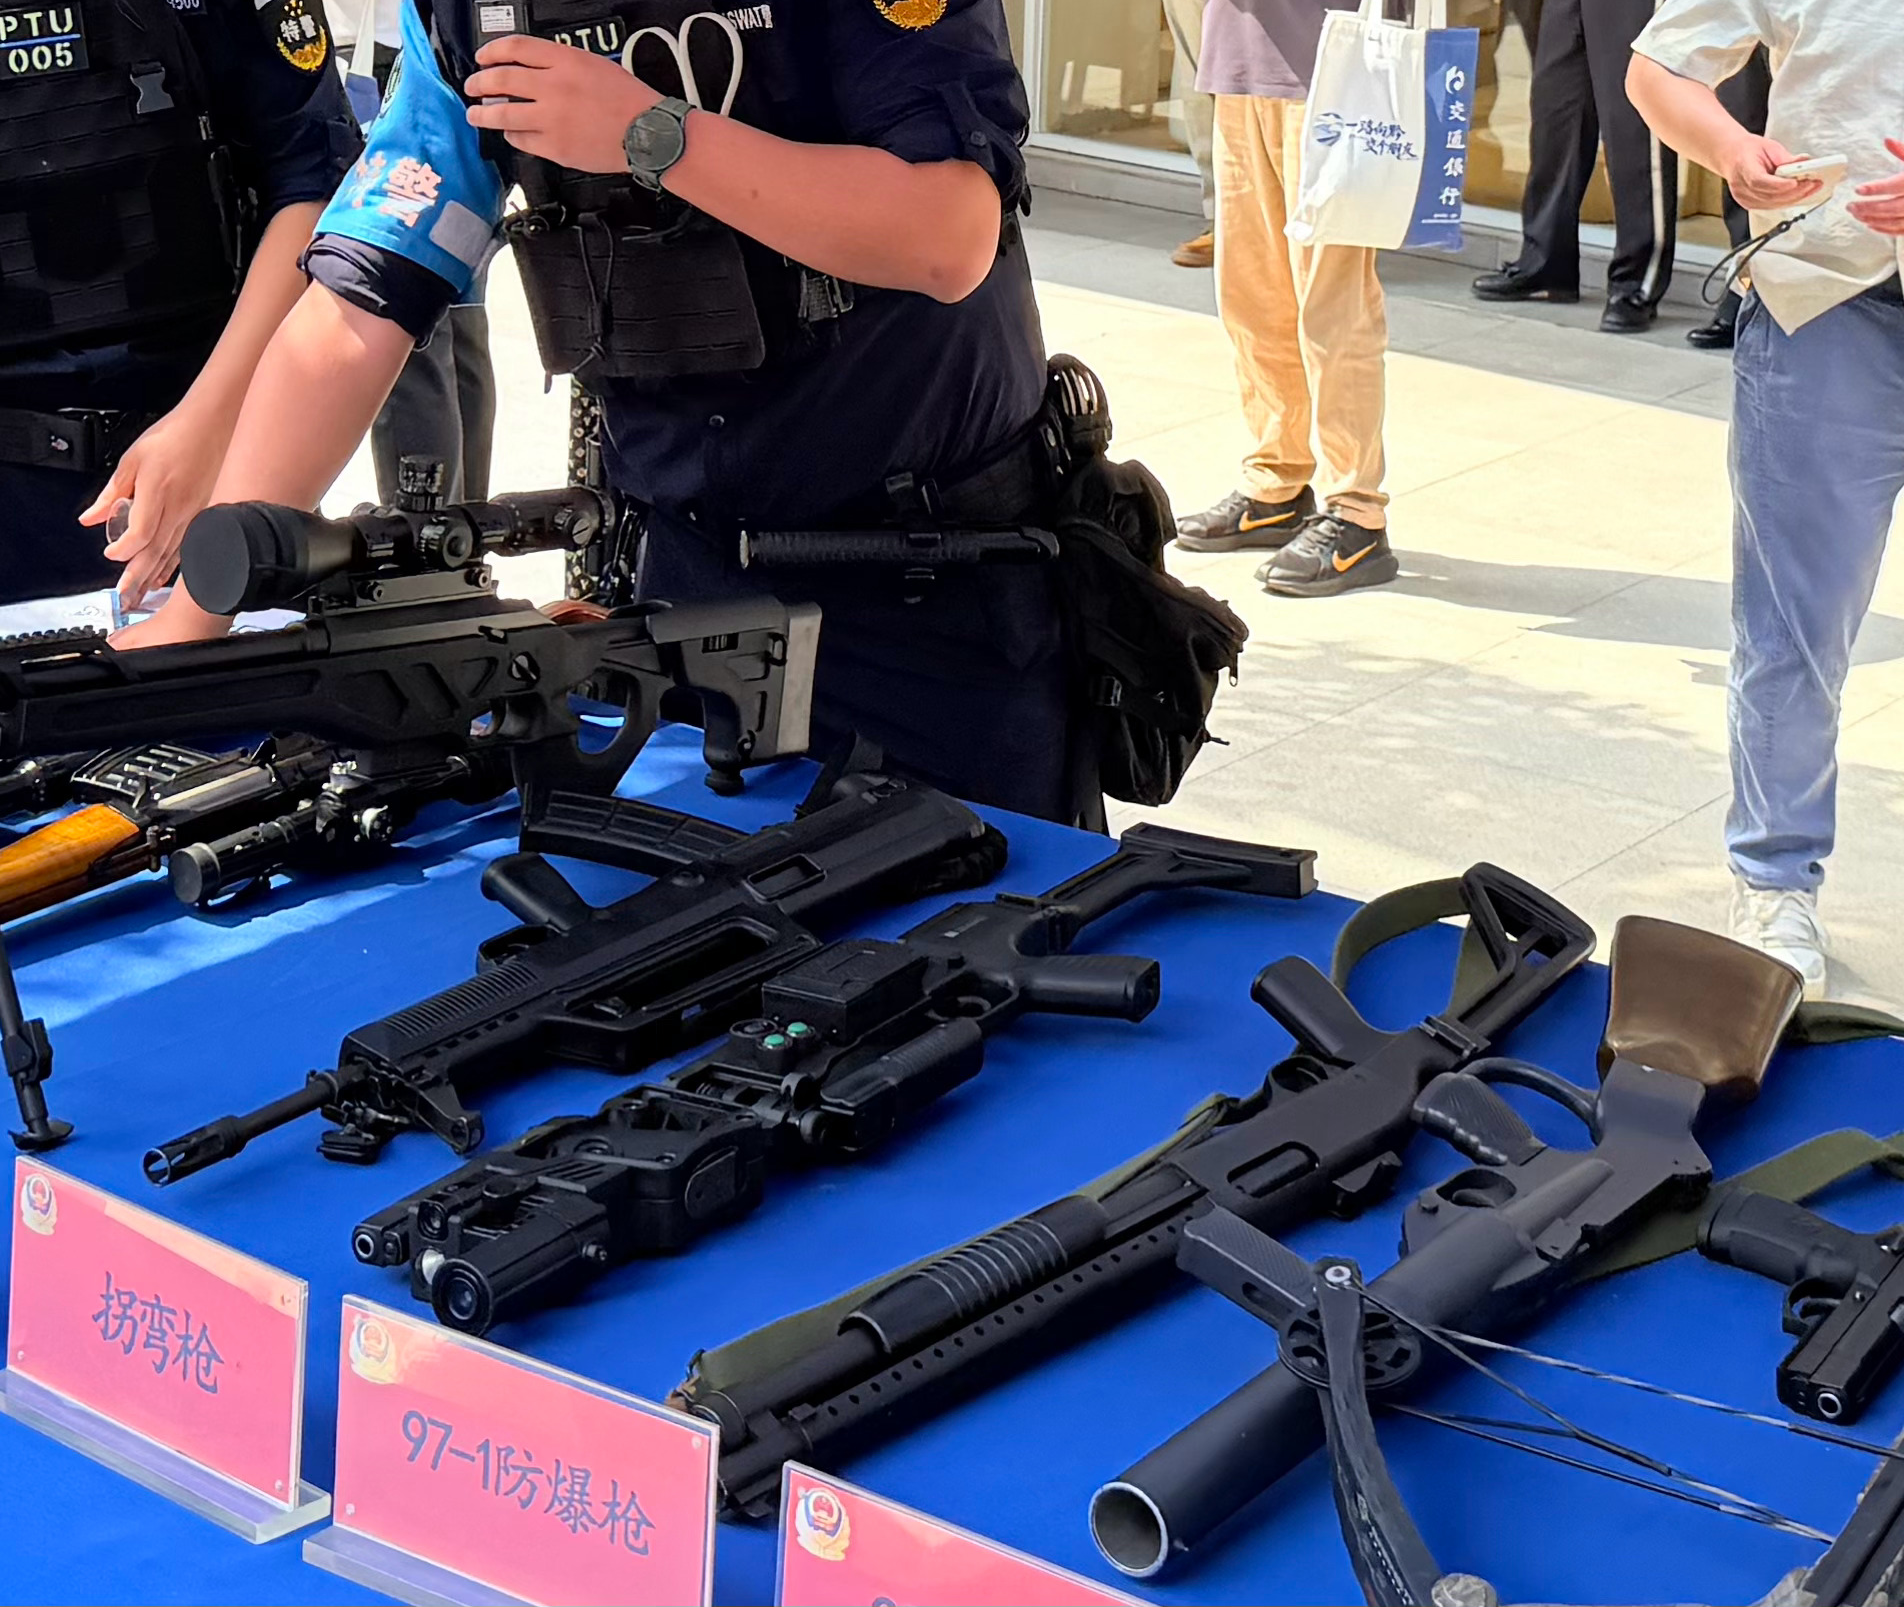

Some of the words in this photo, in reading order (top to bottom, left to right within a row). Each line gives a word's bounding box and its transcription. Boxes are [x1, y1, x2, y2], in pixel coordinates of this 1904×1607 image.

[279, 13, 317, 44] 特警
[8, 42, 74, 73] 005
[1344, 122, 1407, 142] 一路向黔
[1362, 138, 1419, 161] 交个朋友
[1439, 100, 1467, 206] 交通银行
[91, 1271, 225, 1395] 拐弯枪
[401, 1408, 657, 1557] 97-1防爆枪
